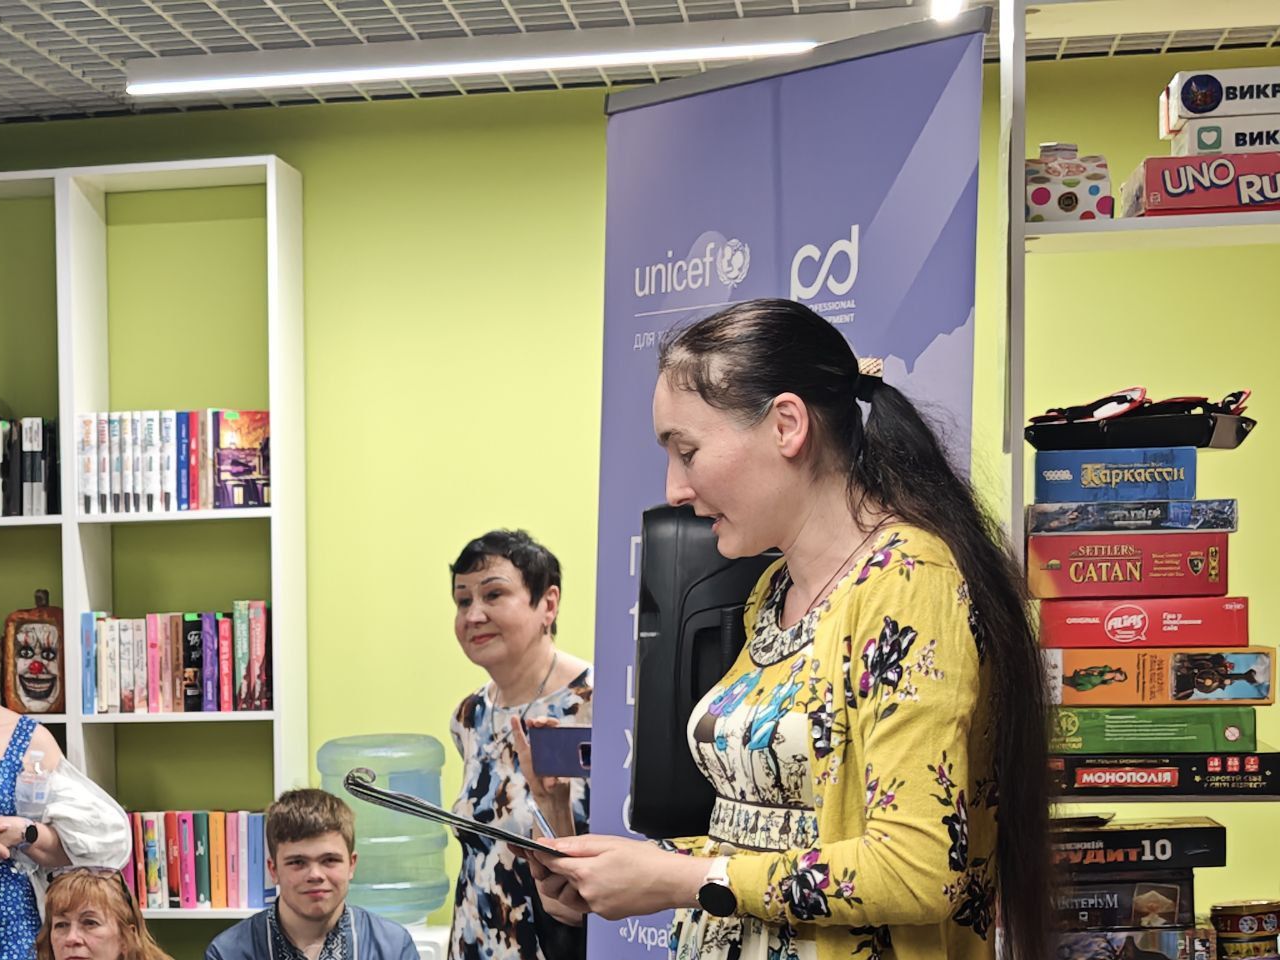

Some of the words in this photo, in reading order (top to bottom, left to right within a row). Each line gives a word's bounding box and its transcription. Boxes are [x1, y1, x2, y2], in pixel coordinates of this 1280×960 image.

[1163, 158, 1235, 195] UNO
[635, 241, 715, 297] unicef
[1078, 544, 1135, 556] SETTLERS
[1069, 561, 1142, 583] CATAN
[1081, 771, 1172, 783] МОНОПОЛІЯ
[1140, 839, 1172, 860] 10
